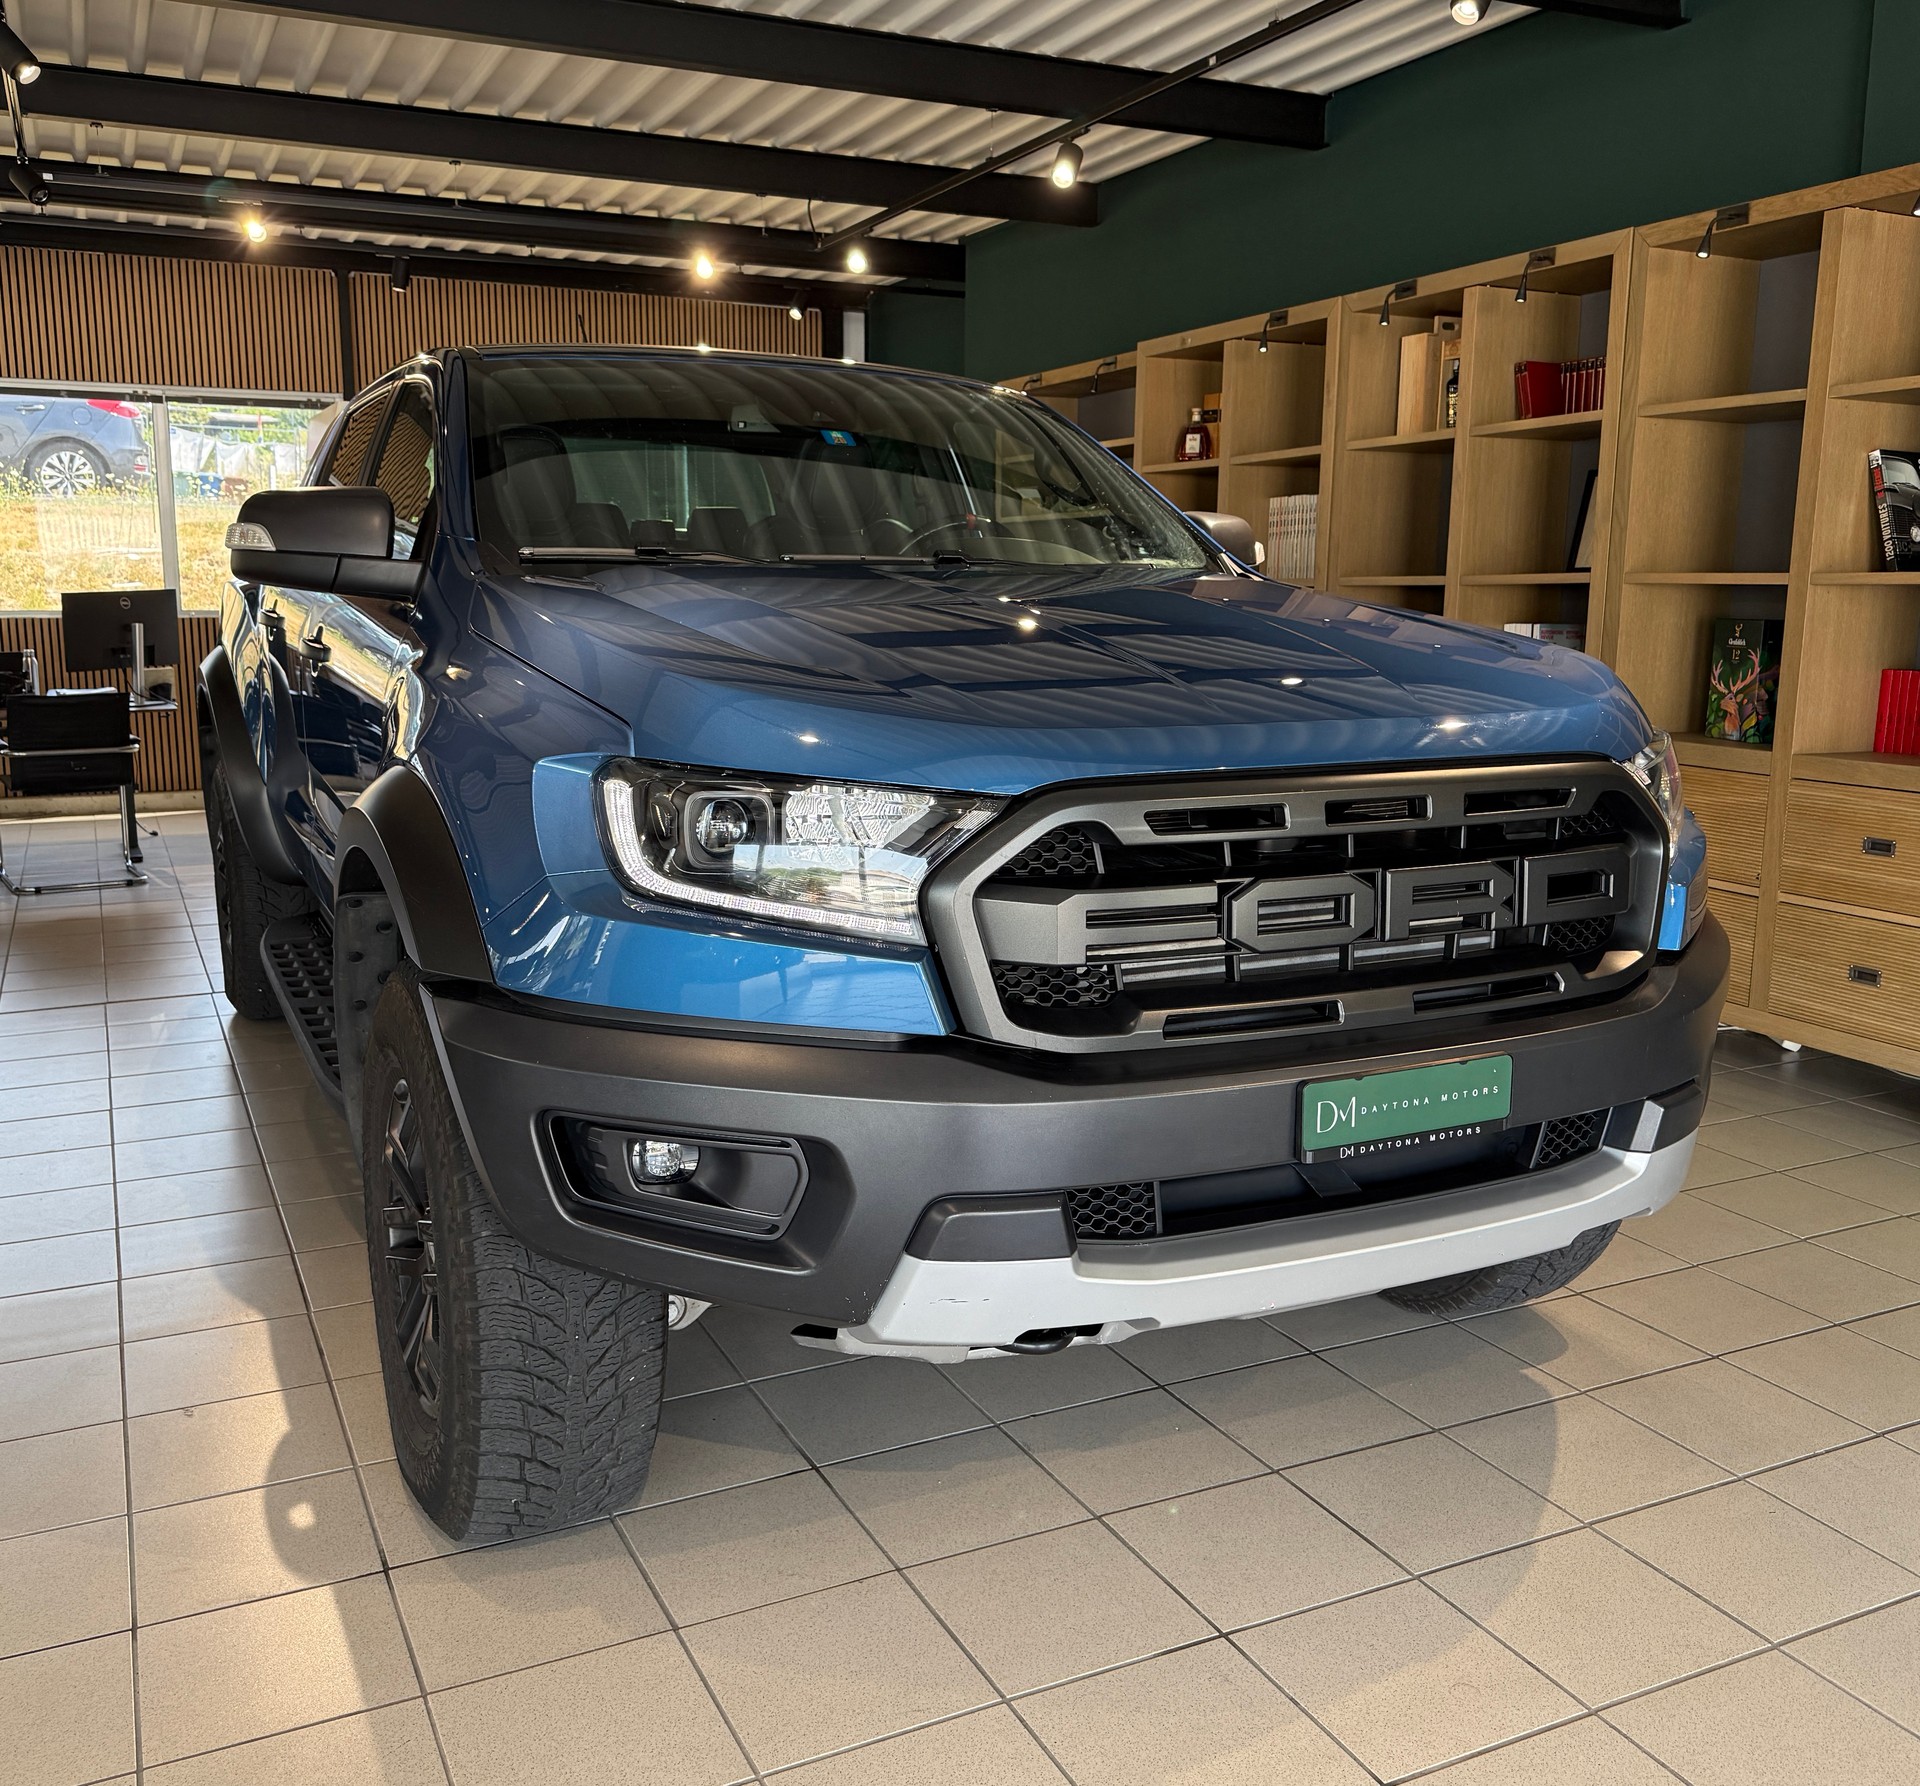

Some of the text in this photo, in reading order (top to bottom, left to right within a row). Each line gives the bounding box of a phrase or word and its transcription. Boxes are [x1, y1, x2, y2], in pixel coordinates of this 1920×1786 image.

[1878, 503, 1892, 541] VOITURES
[1884, 540, 1895, 561] 1200
[1732, 649, 1741, 660] 12
[1057, 847, 1634, 966] FORD
[1361, 1097, 1430, 1115] DAYTONA
[1441, 1085, 1499, 1102] MOTORS
[1360, 1137, 1420, 1154] DAYTONA
[1430, 1126, 1481, 1142] MOTORS
